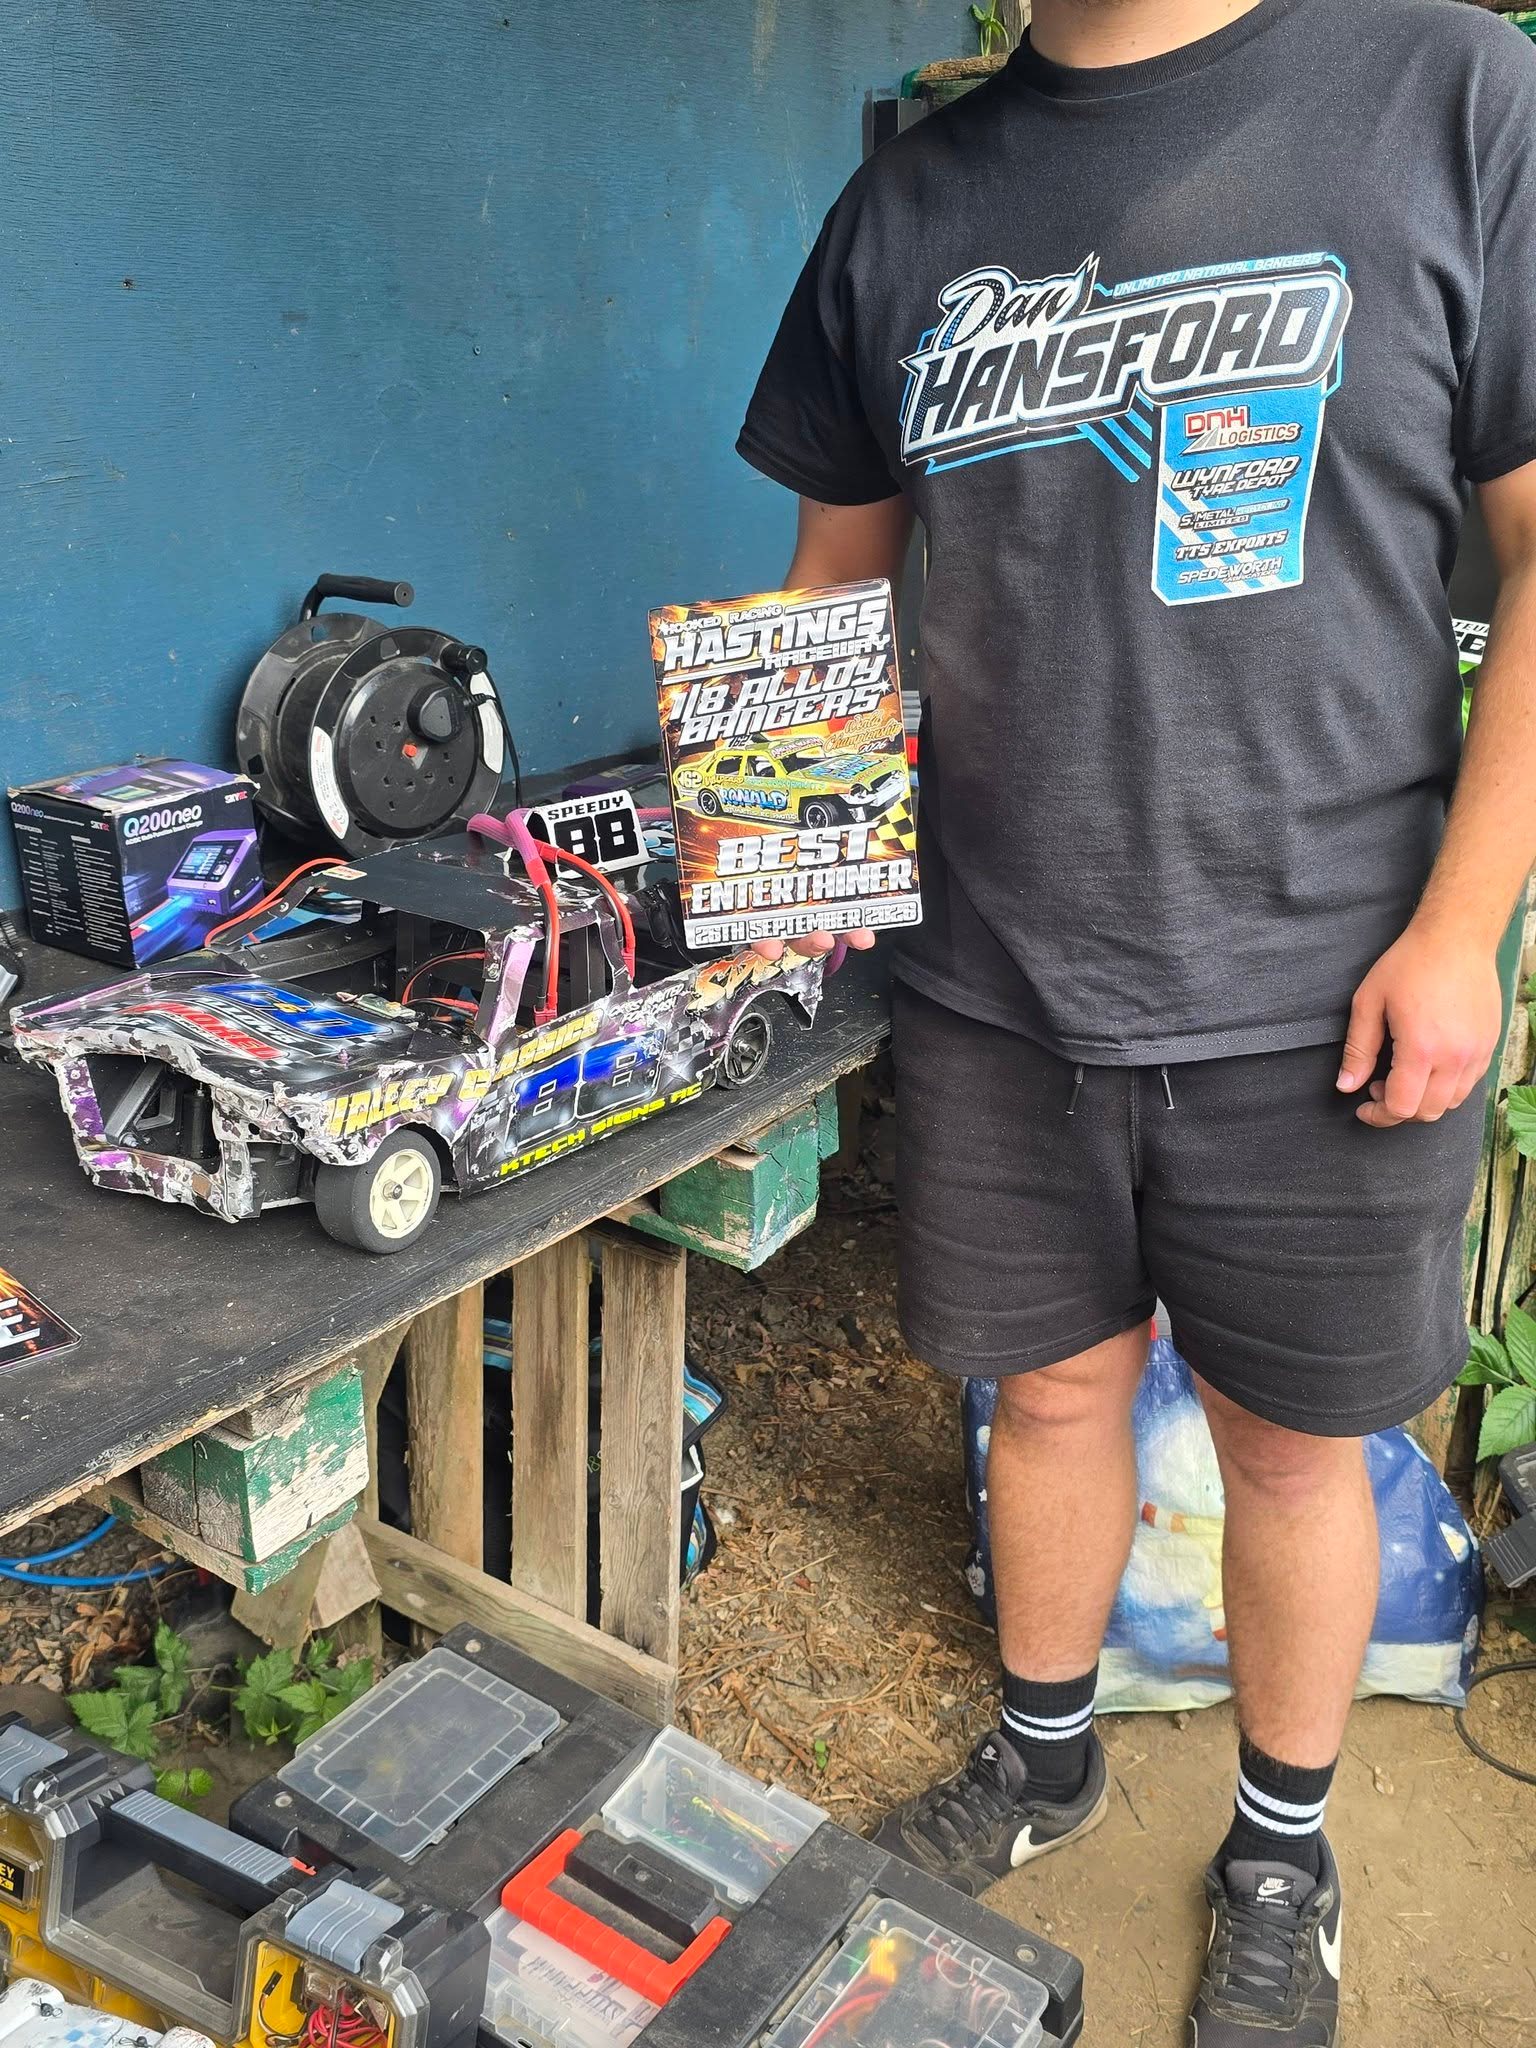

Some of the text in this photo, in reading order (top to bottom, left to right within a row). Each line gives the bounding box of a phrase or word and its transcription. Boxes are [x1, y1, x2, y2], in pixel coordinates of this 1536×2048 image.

[1113, 253, 1322, 298] UNLIMITED NATIONAL BANGERS
[938, 278, 1074, 351] Dan
[908, 286, 1330, 443] HANSFORD
[1187, 408, 1245, 435] DNH
[1218, 424, 1298, 446] LOGISTICS
[1172, 456, 1301, 489] WYNFORD
[1192, 471, 1294, 497] TYRE DEPOT
[1195, 508, 1234, 521] METAL
[1175, 530, 1289, 561] TTS EXPORTS
[1177, 556, 1284, 585] SPEDEWORTH
[661, 604, 785, 637] HOOKED RACING
[663, 596, 890, 672] HASTINGS
[763, 633, 892, 671] RACEWAY
[734, 653, 888, 709] ALLOY
[678, 684, 882, 747] BANGERS
[858, 739, 888, 754] 2026
[124, 804, 202, 838] Q200neo
[548, 796, 624, 820] SPEEDY
[554, 808, 639, 865] 88
[715, 822, 880, 878] BEST
[691, 858, 913, 915] ENTERTAINER
[748, 908, 862, 941] SEPTEMBER
[506, 1027, 667, 1150] 88
[590, 1098, 666, 1135] SIGNS
